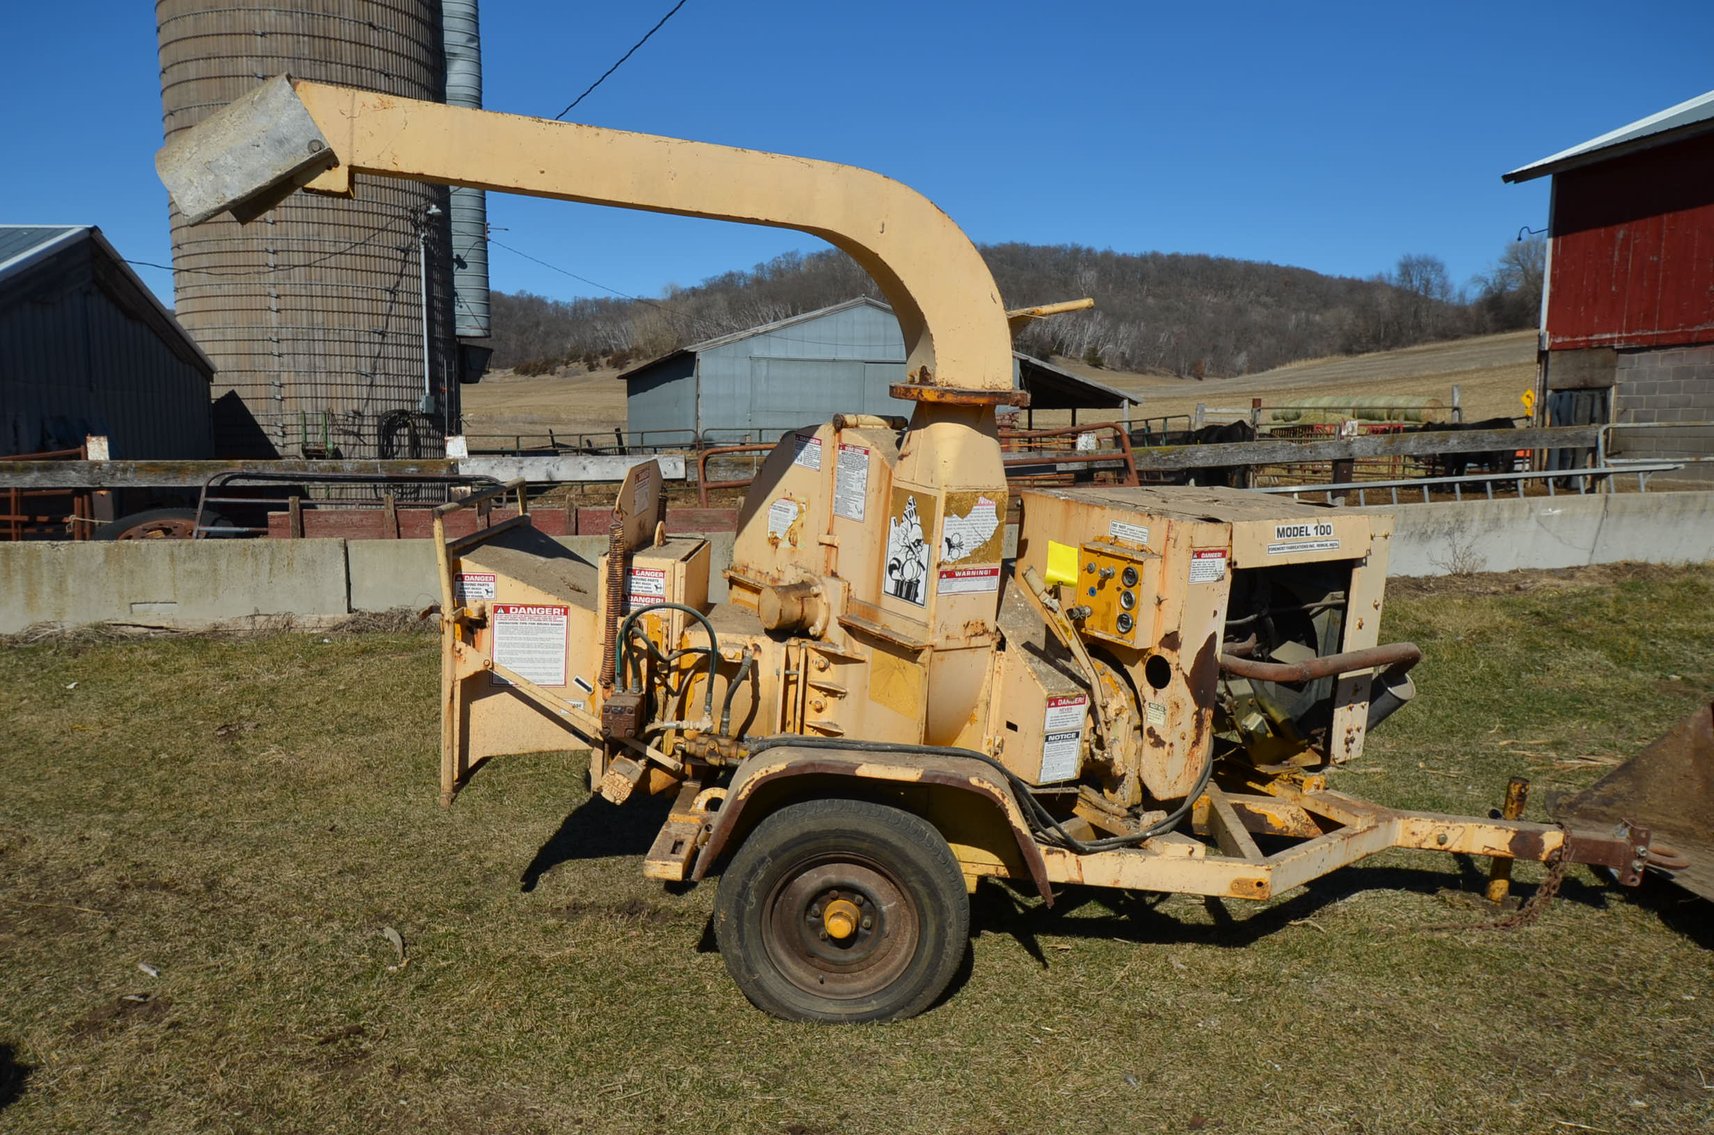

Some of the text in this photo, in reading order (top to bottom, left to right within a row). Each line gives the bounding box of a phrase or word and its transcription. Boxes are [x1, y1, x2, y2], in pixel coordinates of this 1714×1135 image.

[1277, 525, 1332, 538] MODEL 100
[955, 569, 991, 577] WARNING!
[509, 607, 564, 615] DANGER!
[1048, 733, 1077, 742] NOTICE
